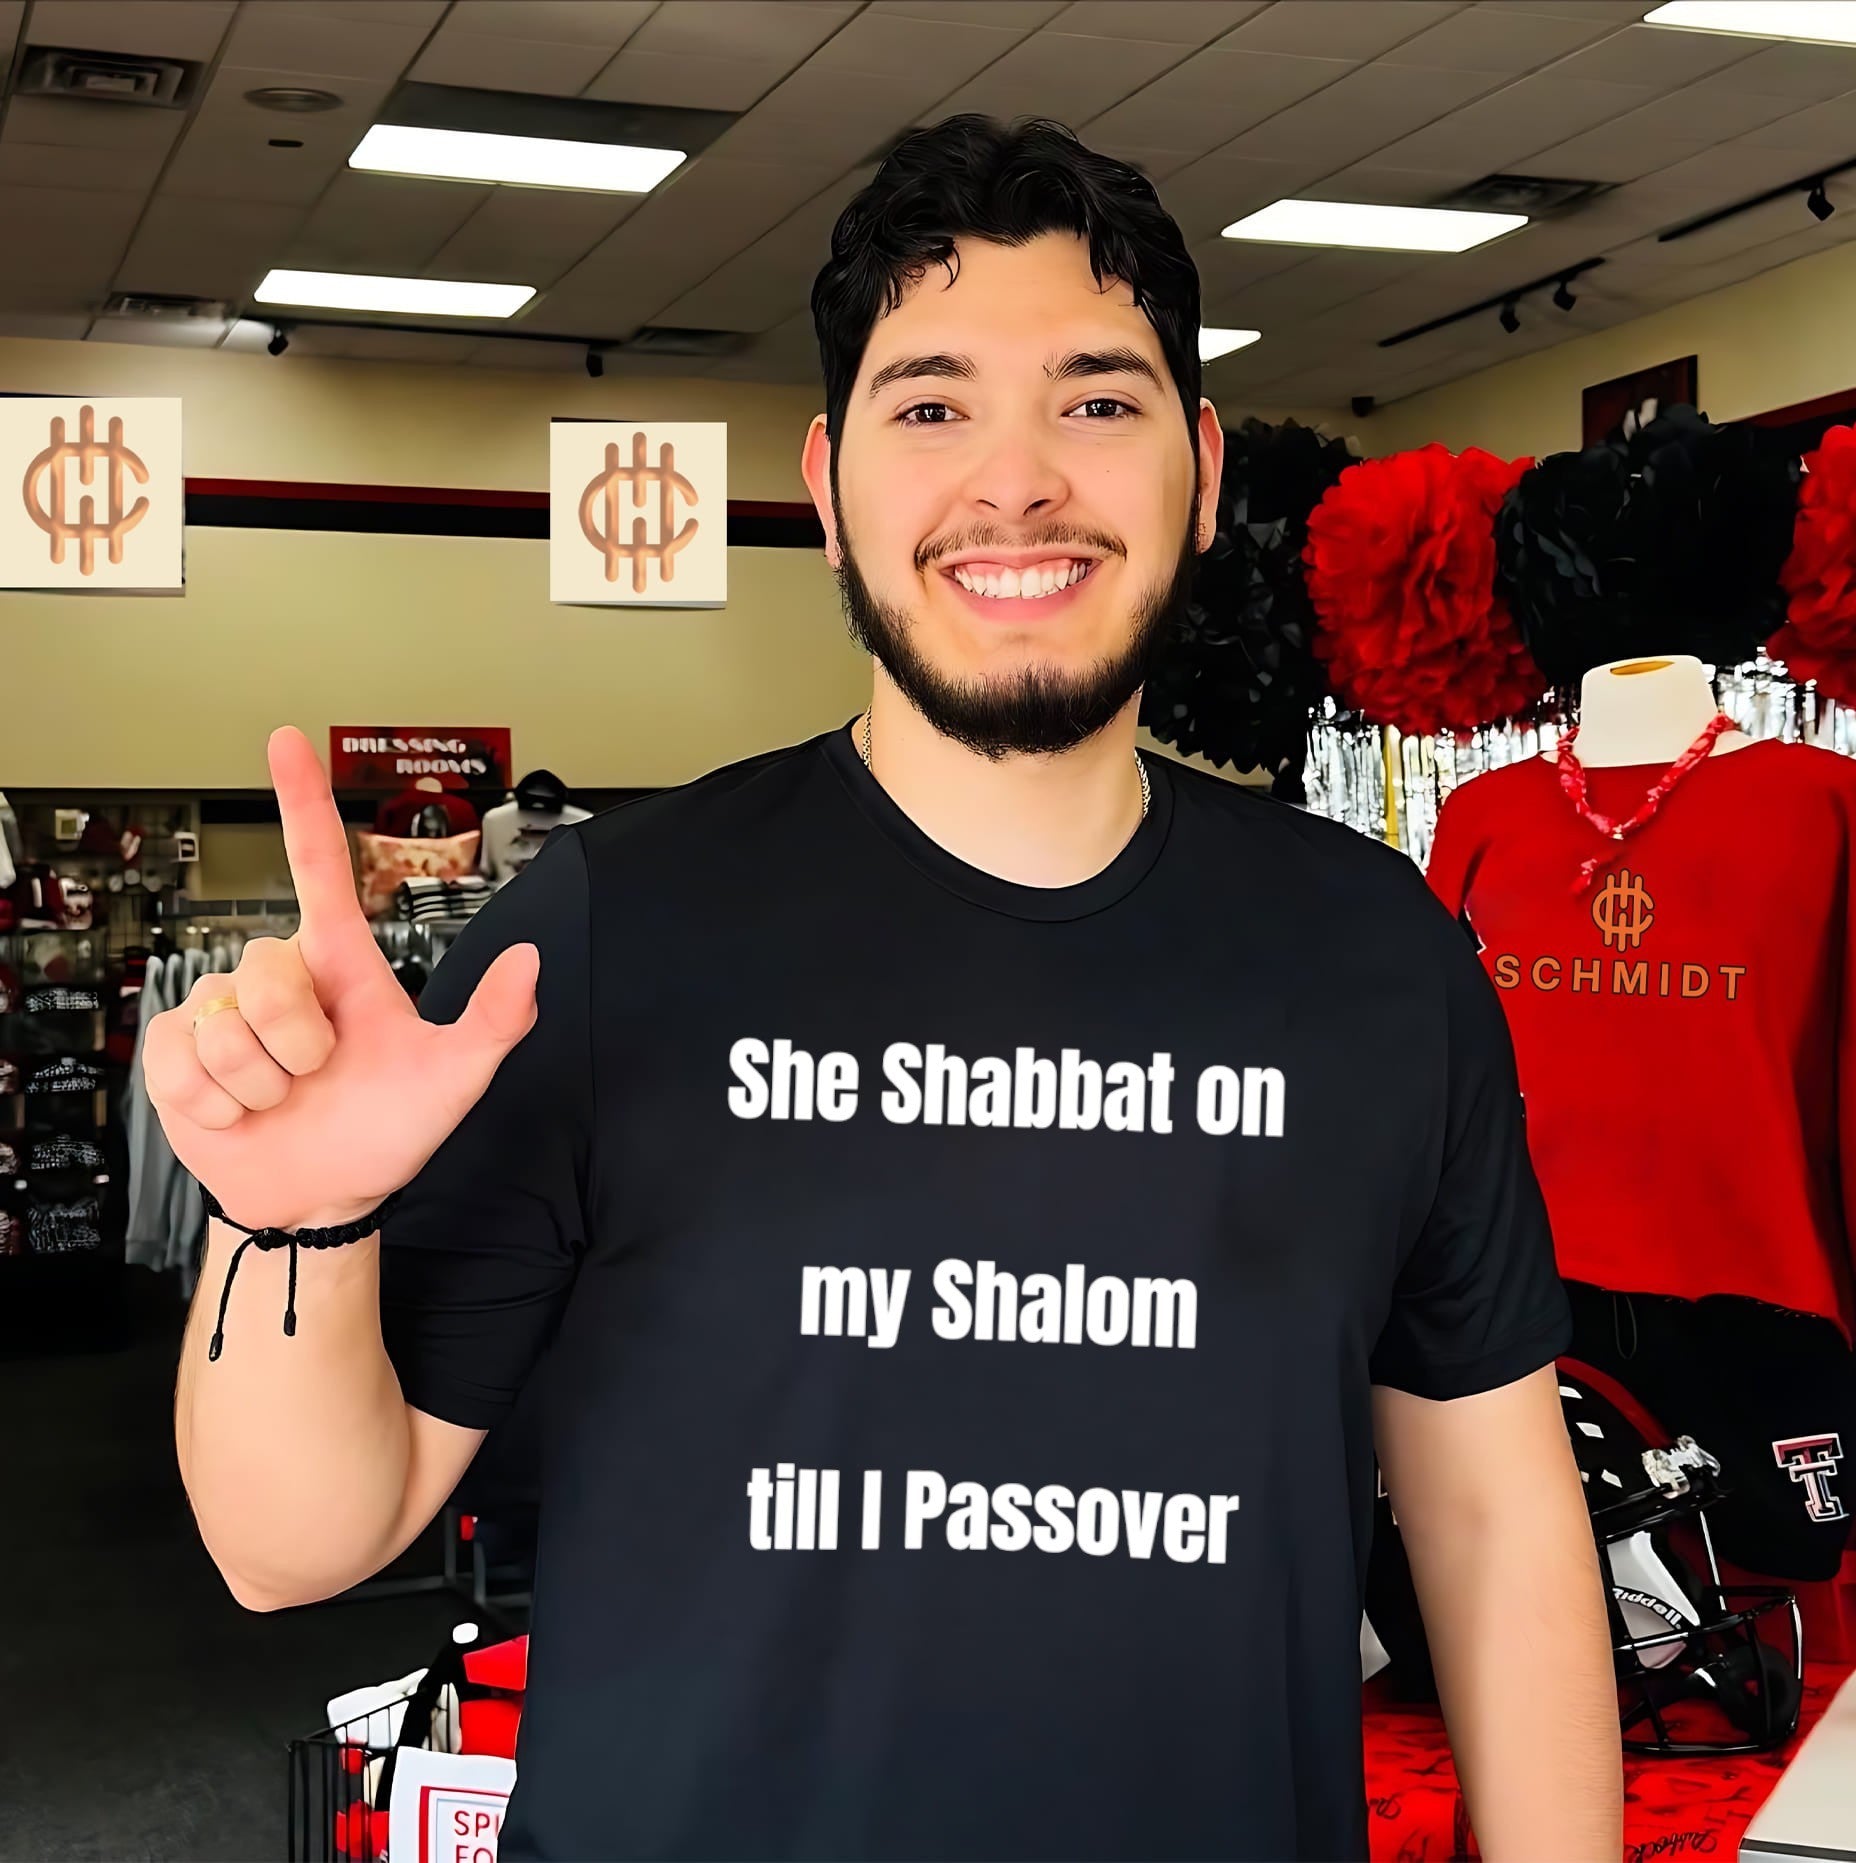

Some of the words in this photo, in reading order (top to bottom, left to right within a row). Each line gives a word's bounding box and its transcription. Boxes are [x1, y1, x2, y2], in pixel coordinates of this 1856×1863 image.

[342, 737, 467, 754] DRESSING
[396, 758, 487, 775] ROOMS
[1494, 954, 1746, 1000] SCHMIDT
[727, 1037, 859, 1121] She
[880, 1041, 1174, 1134] Shabbat
[1196, 1065, 1286, 1138] on
[800, 1265, 911, 1348] my
[931, 1258, 1197, 1348] Shalom
[746, 1463, 840, 1551] till
[861, 1470, 882, 1550] I
[904, 1470, 1240, 1564] Passover
